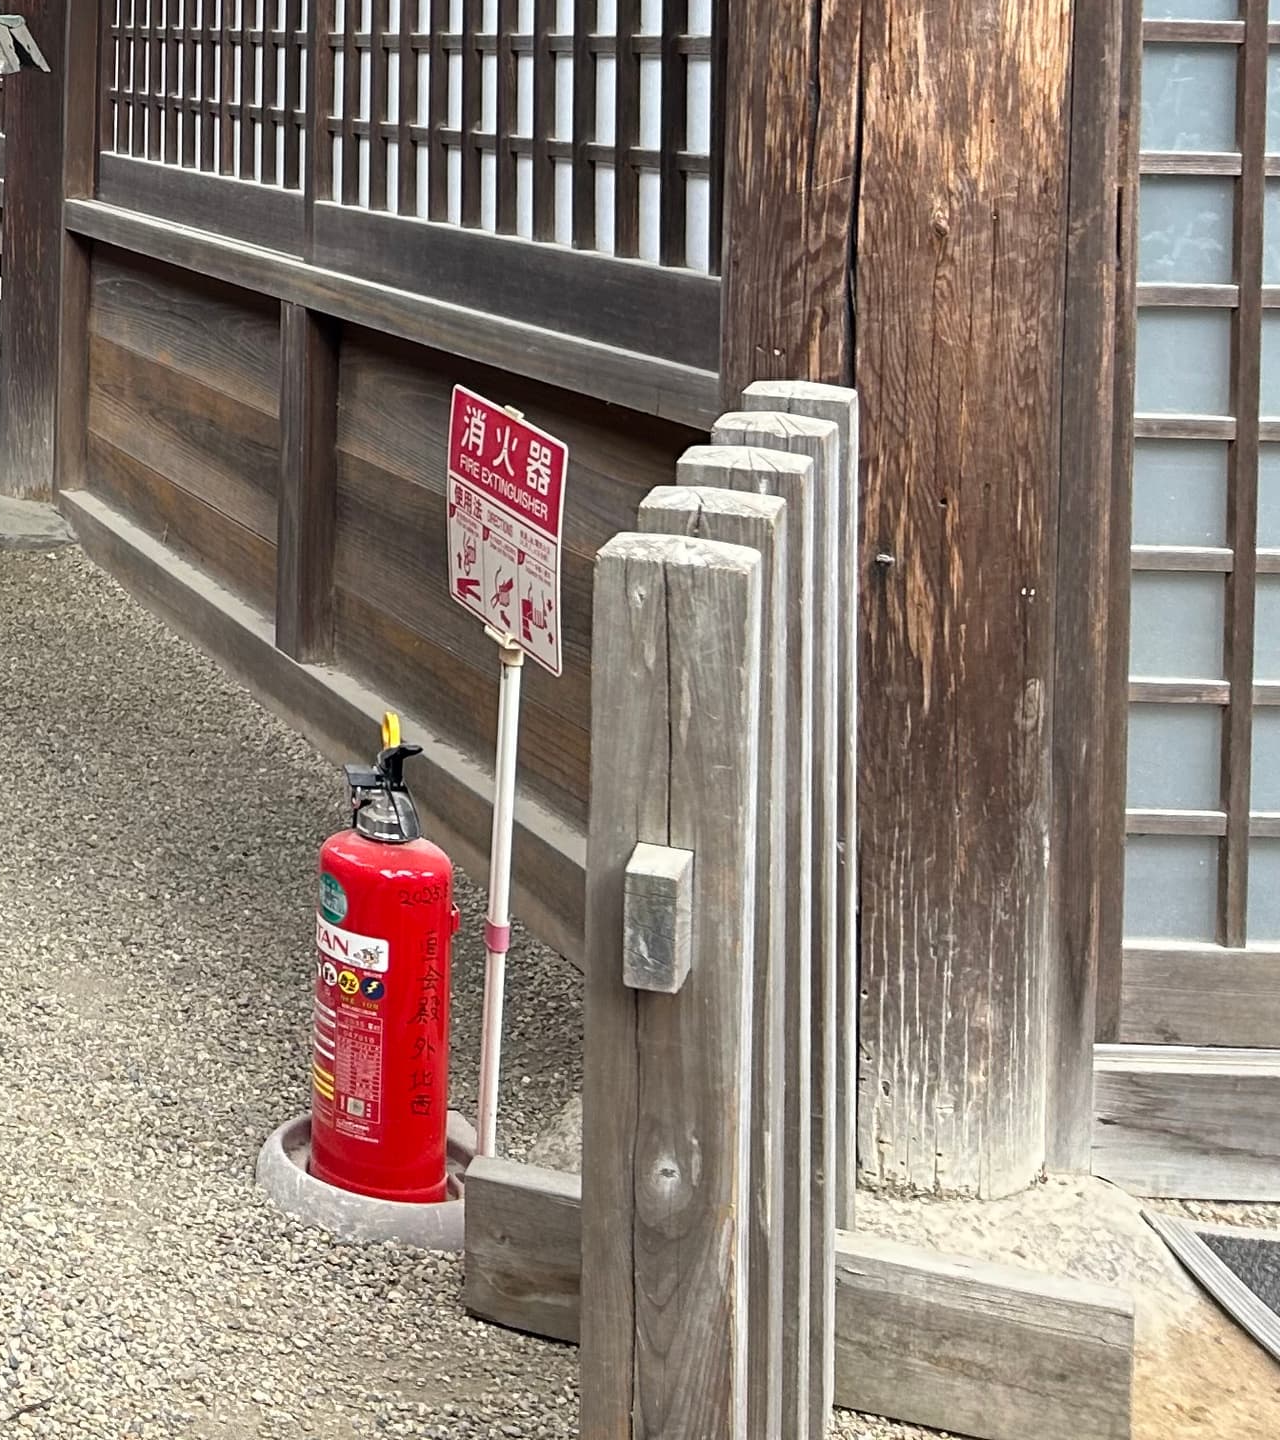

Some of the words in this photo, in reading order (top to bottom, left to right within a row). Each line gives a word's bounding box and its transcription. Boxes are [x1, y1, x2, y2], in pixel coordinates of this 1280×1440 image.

[459, 453, 480, 480] FIRE
[481, 466, 548, 522] EXTINGUISHER
[461, 405, 552, 496] 消火器
